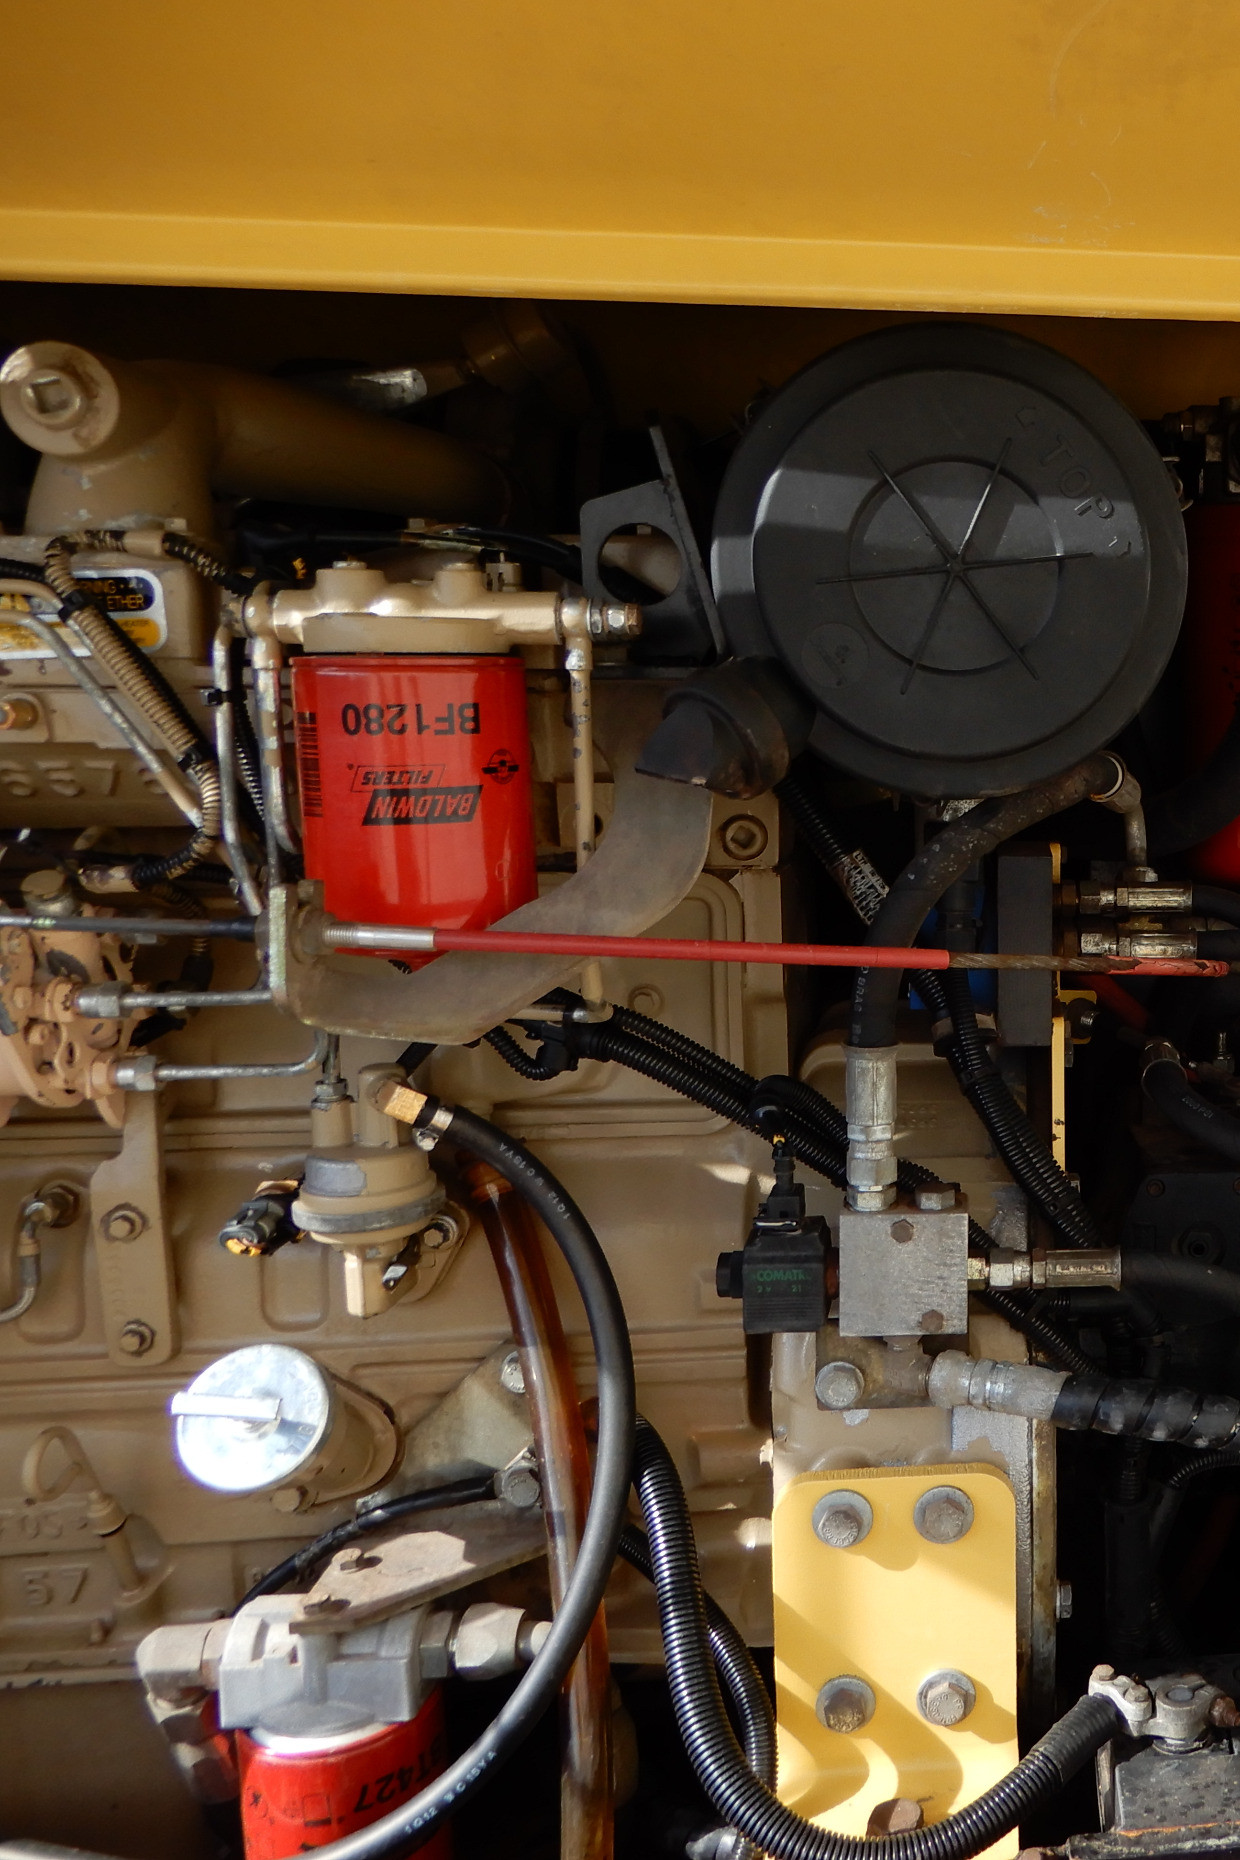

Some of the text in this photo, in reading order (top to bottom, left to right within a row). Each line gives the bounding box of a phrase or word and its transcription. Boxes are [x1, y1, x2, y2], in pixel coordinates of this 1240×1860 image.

[1040, 434, 1116, 519] TOP
[341, 702, 481, 736] BF1280
[361, 770, 434, 788] FILTERS
[371, 793, 475, 820] BALDWIN
[22, 1563, 89, 1605] 57
